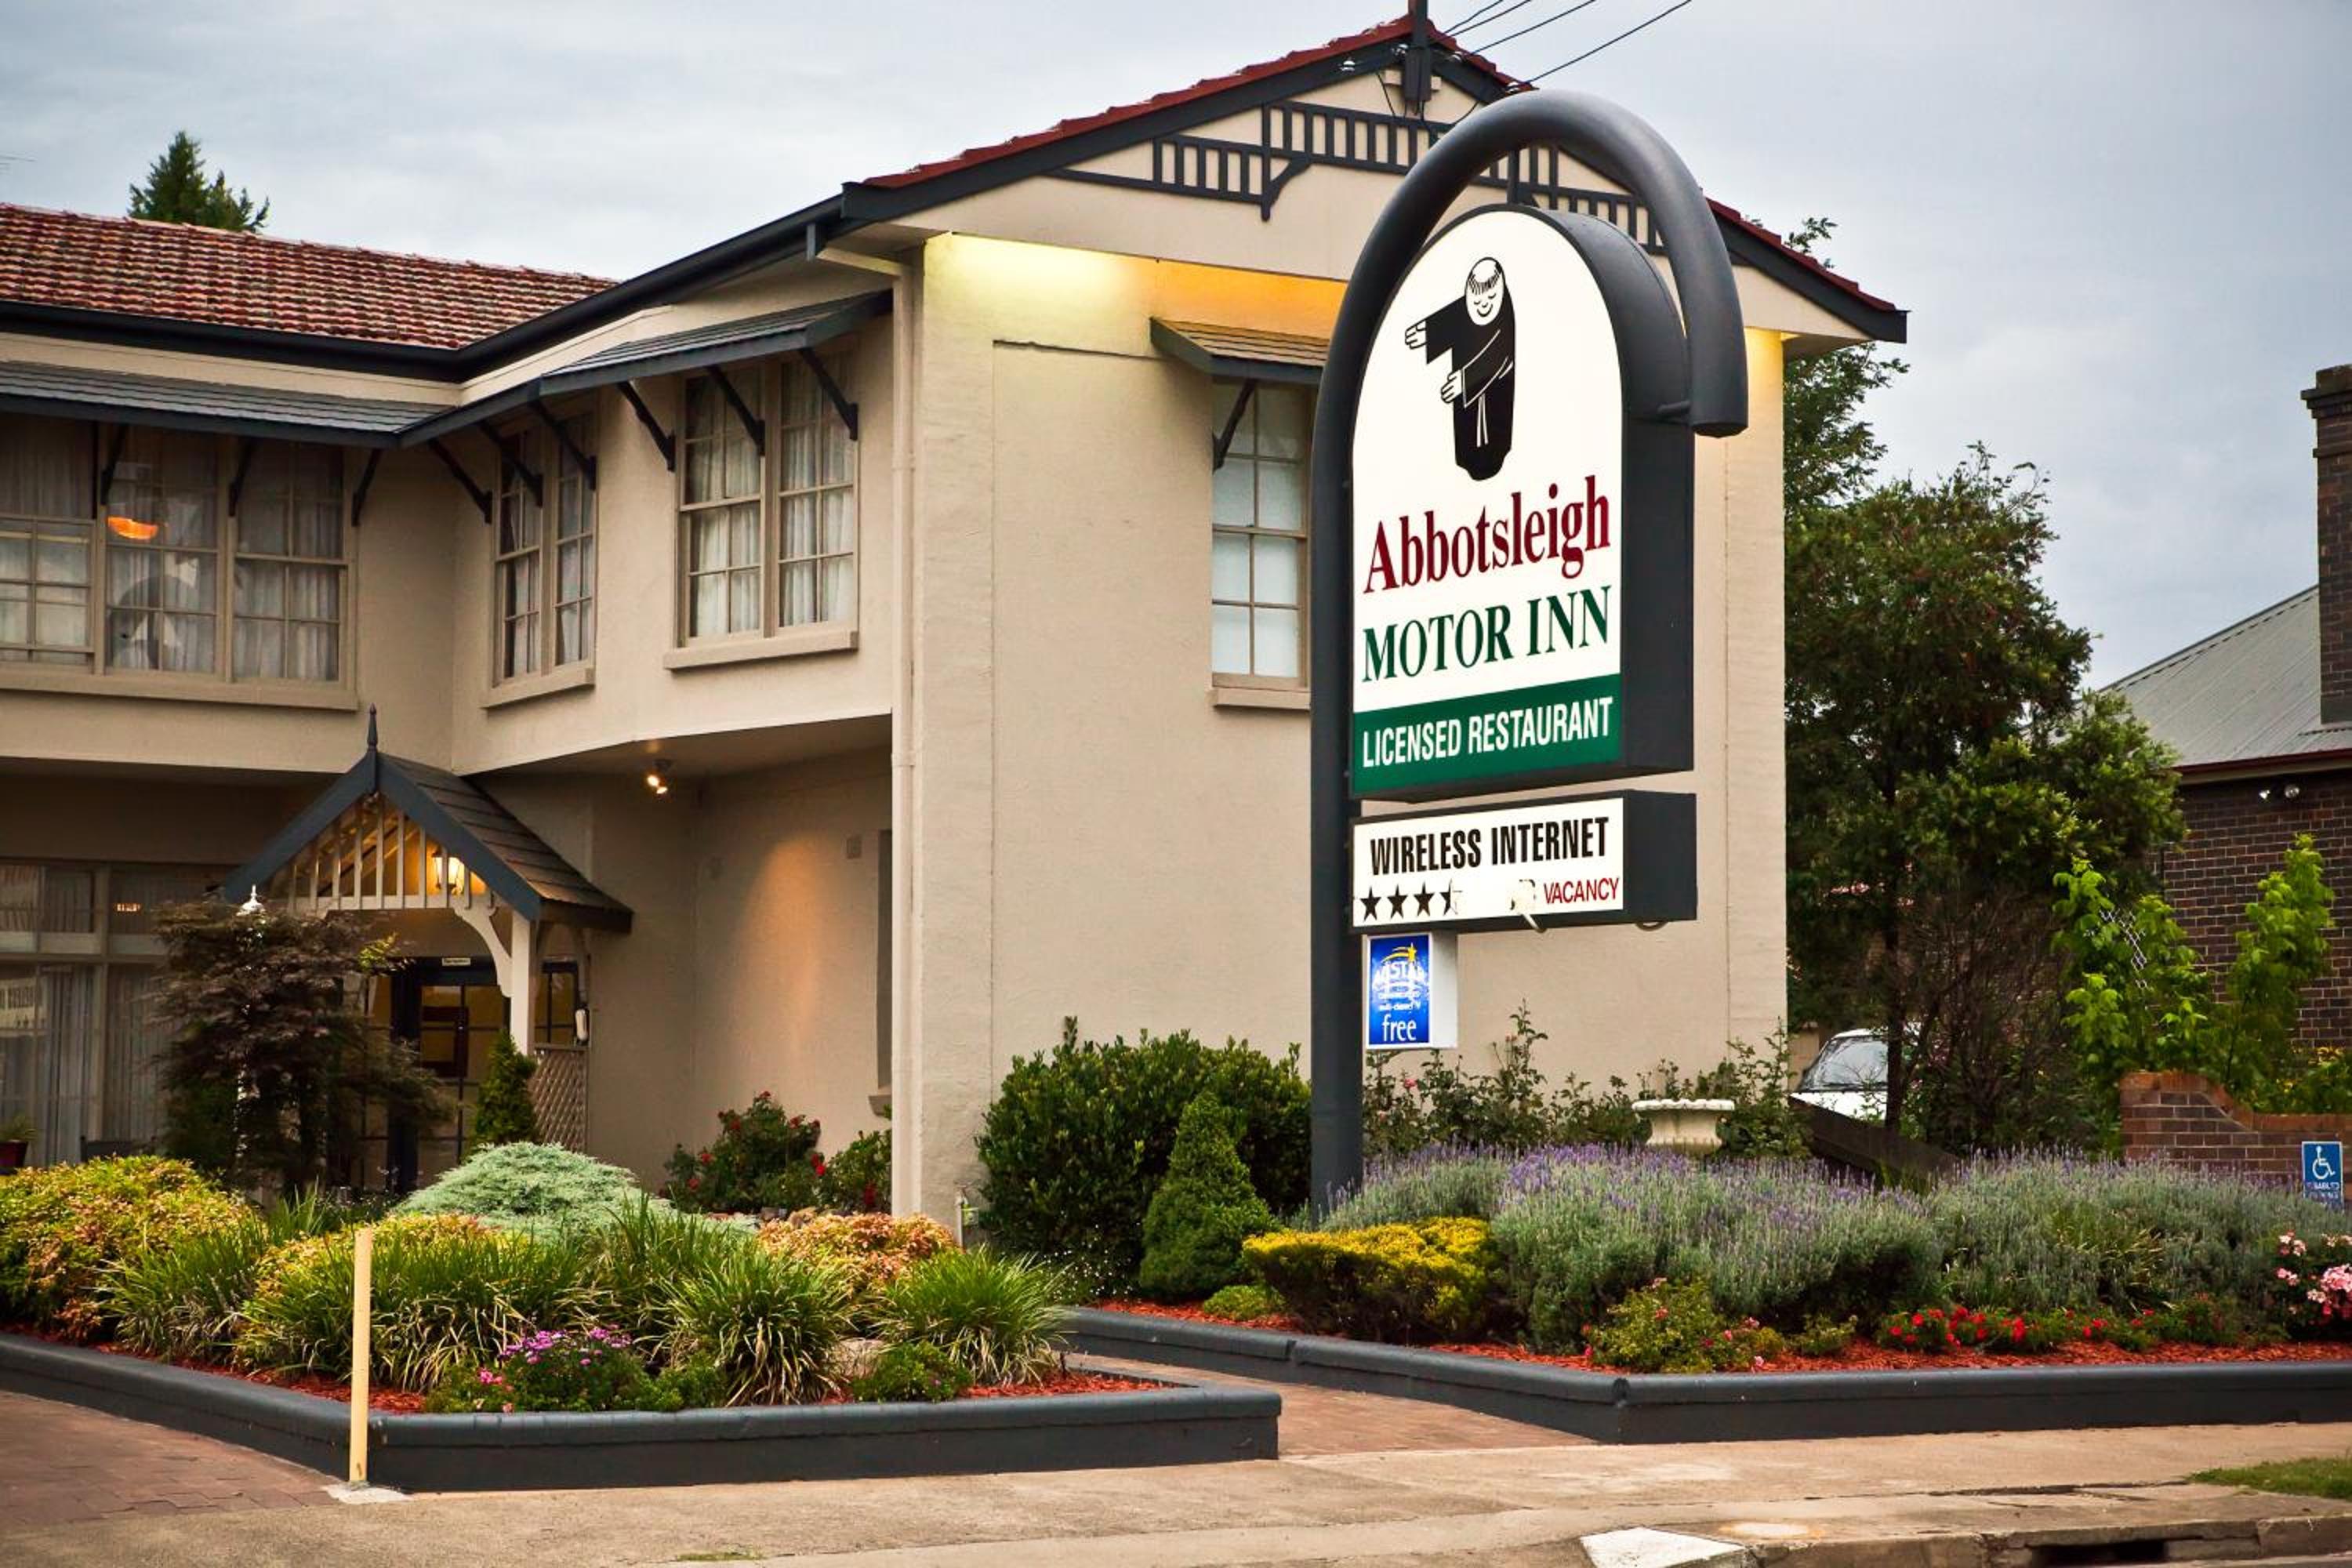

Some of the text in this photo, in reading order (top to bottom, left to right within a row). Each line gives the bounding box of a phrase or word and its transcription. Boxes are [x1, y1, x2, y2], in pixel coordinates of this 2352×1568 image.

[1363, 474, 1611, 593] Abbotsleigh
[1362, 585, 1612, 683] MOTOR INN
[1363, 696, 1613, 768] LICENSED RESTAURANT
[1370, 816, 1610, 876] WIRELESS INTERNET
[1543, 877, 1620, 904] VACANCY
[1381, 1014, 1417, 1042] free
